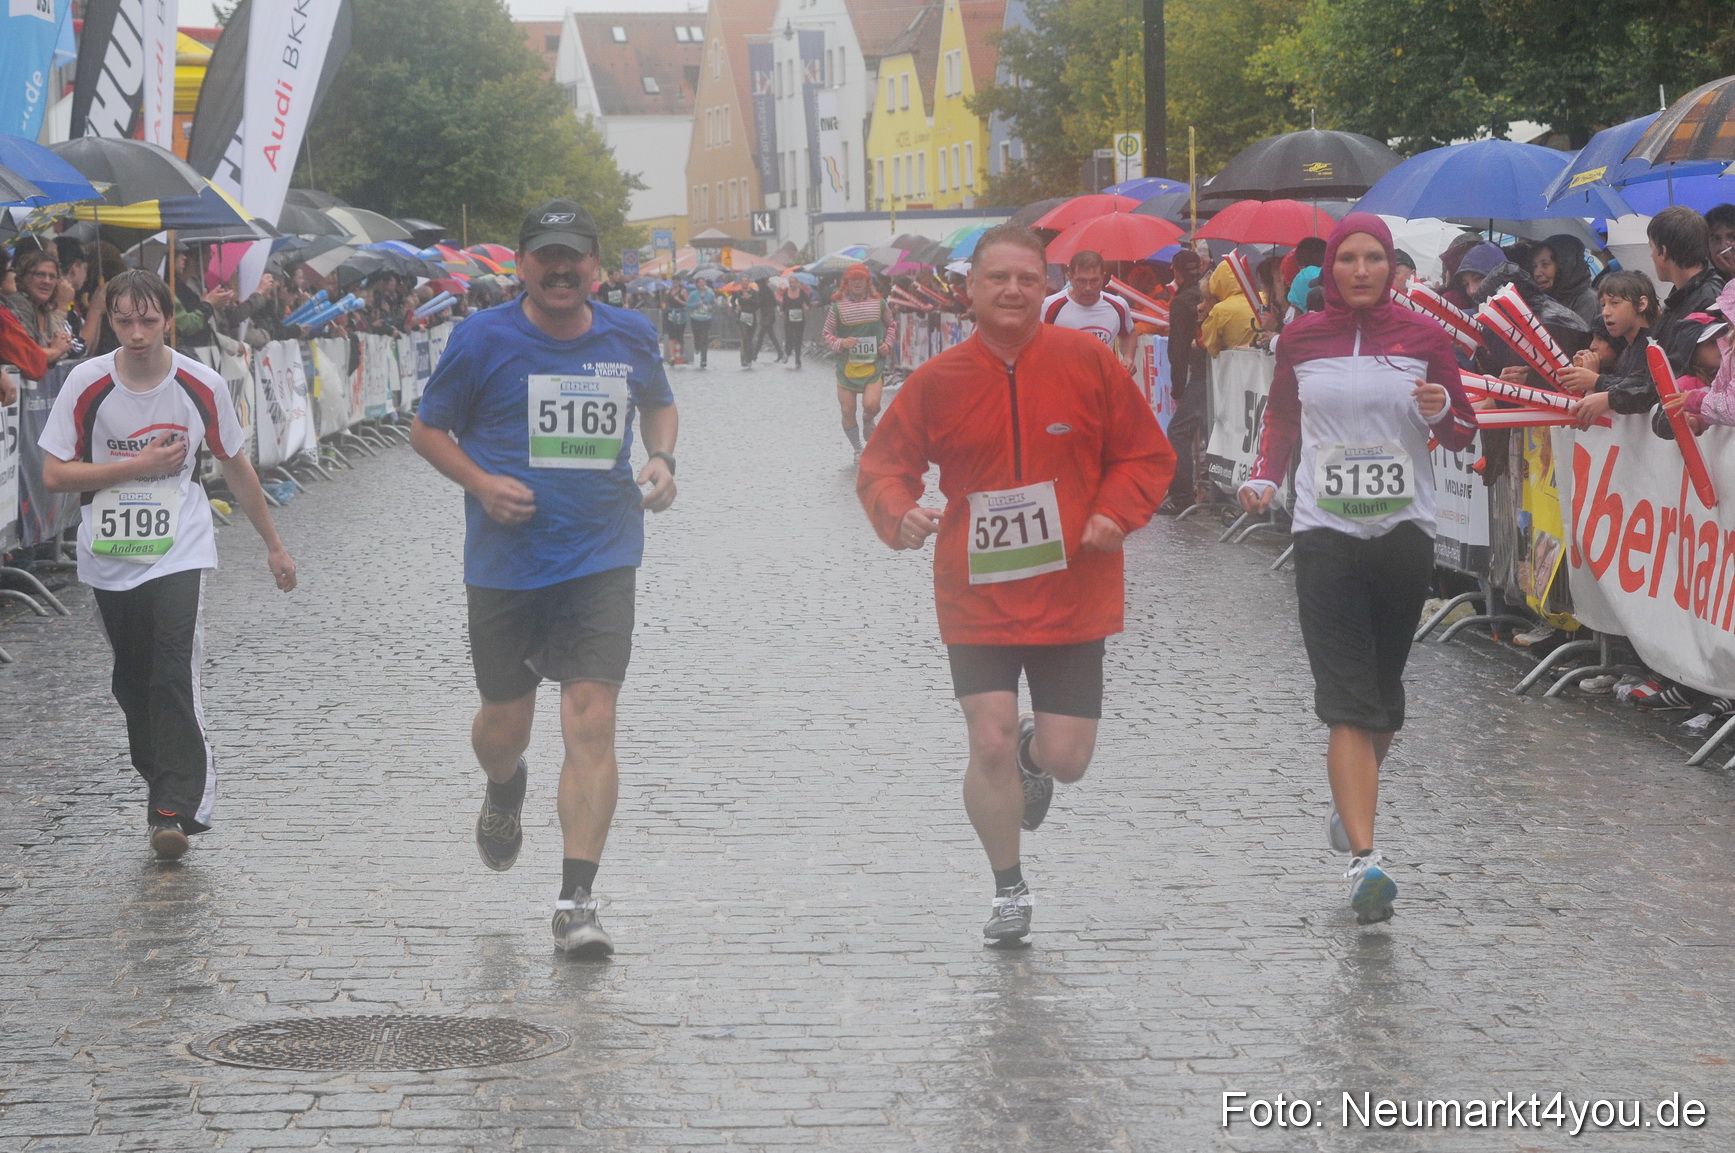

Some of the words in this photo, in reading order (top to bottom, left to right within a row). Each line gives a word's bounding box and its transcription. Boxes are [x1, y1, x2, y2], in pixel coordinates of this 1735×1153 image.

[85, 0, 143, 137] HU
[263, 79, 293, 172] Audi
[753, 213, 774, 233] KL
[582, 363, 595, 371] 12.
[560, 381, 600, 391] BOCK
[1484, 379, 1578, 412] USTRIA
[539, 400, 618, 436] 5163
[561, 441, 596, 456] Erwin
[1325, 463, 1405, 496] 5133
[119, 492, 153, 501] BOCK
[988, 493, 1026, 507] BOCK
[1342, 501, 1388, 515] Kathrin
[101, 508, 171, 538] 5198
[975, 507, 1049, 550] 5211
[110, 543, 154, 554] Andreas
